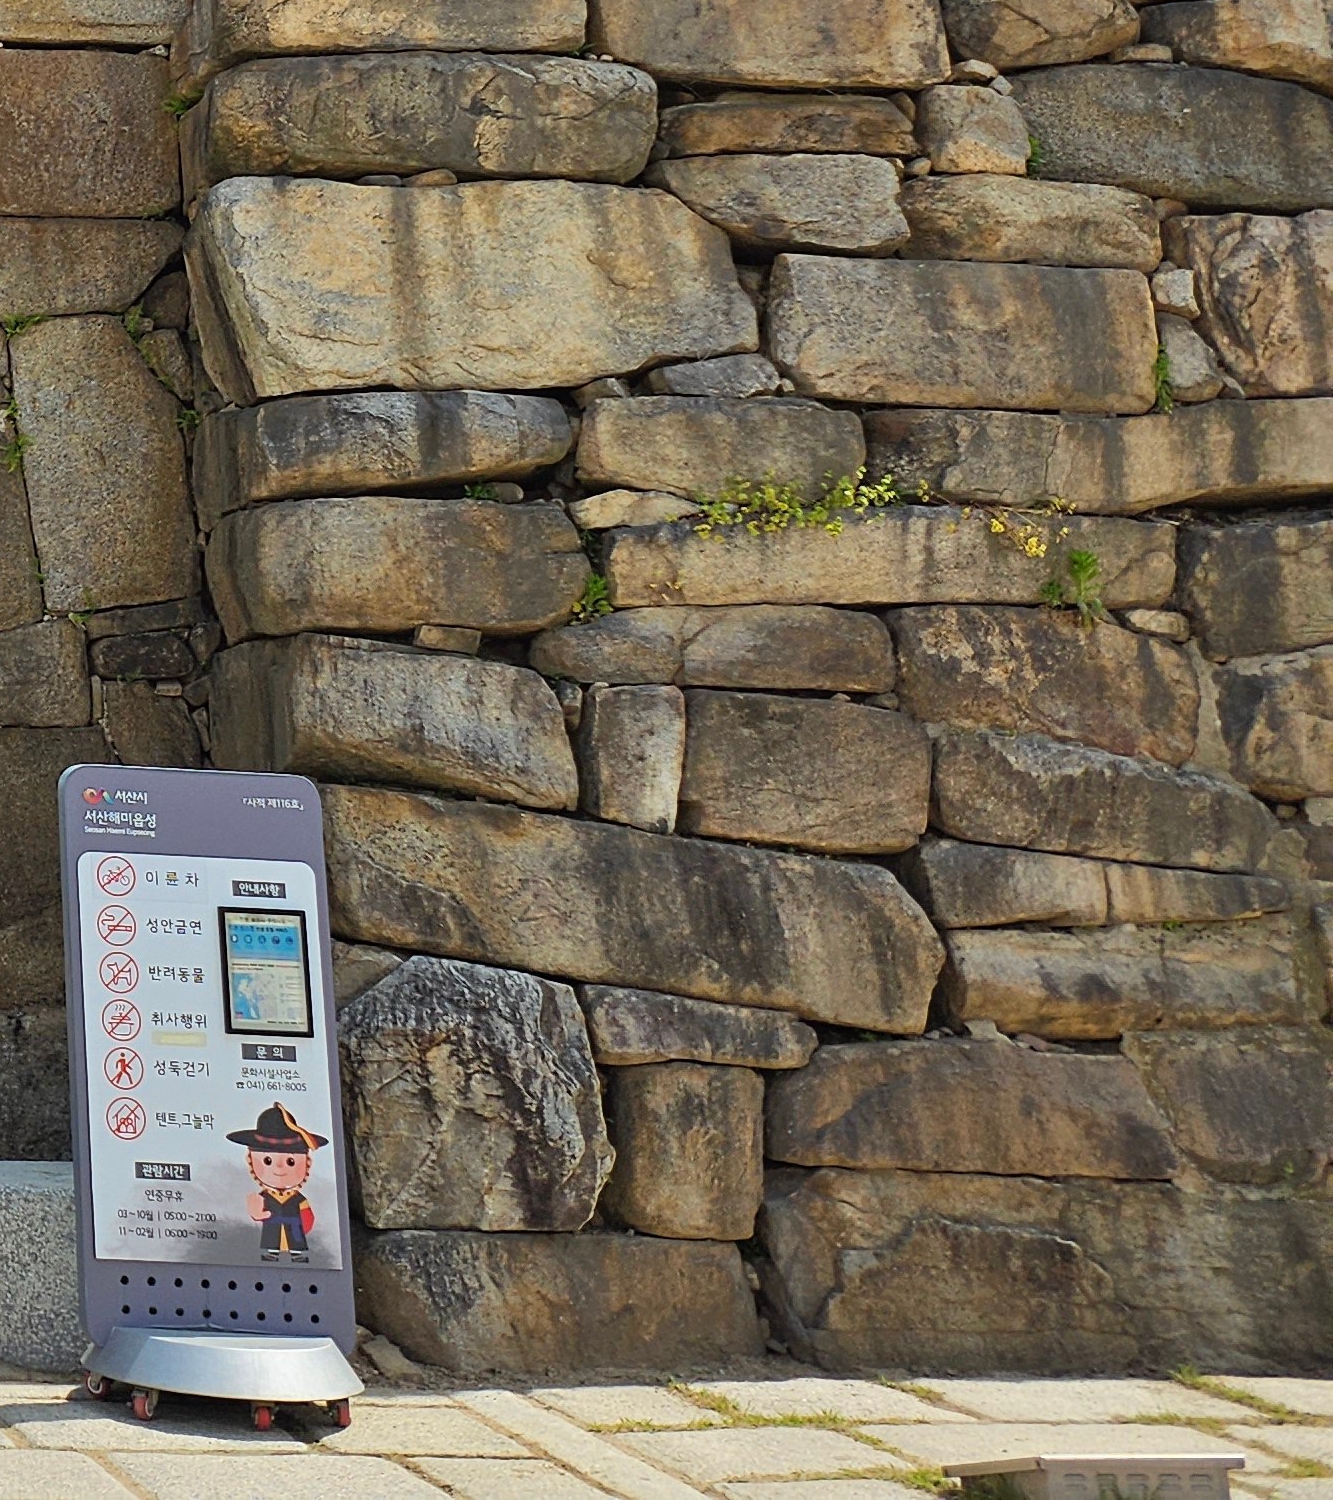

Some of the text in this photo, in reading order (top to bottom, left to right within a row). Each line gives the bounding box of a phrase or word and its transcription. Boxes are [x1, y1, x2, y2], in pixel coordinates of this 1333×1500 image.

[115, 789, 148, 805] 서산시
[84, 810, 157, 828] 서산해미읍성
[146, 918, 203, 936] 성안금연
[148, 965, 205, 984] 반려동물
[151, 1011, 207, 1029] 취사행위
[153, 1059, 210, 1078] 성둑걷기
[241, 1067, 301, 1080] 문화시설사업소
[141, 1163, 185, 1178] 관람시간
[144, 1189, 185, 1202] 연중무휴
